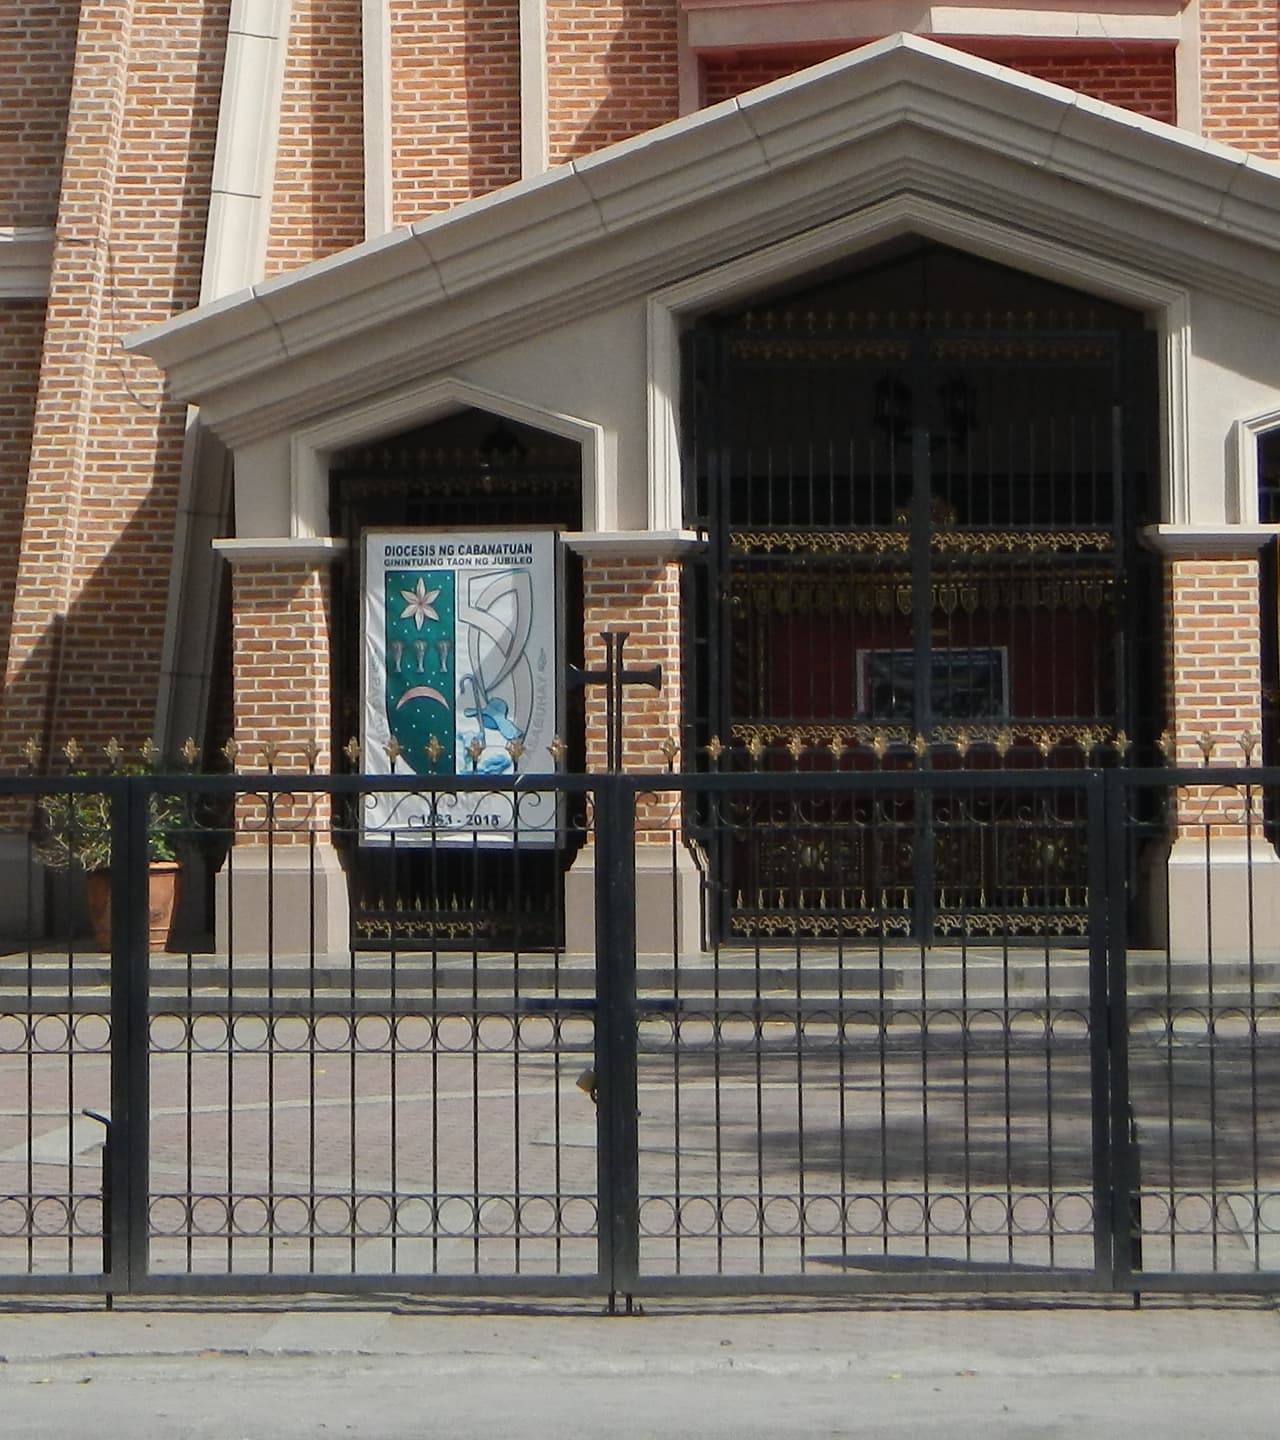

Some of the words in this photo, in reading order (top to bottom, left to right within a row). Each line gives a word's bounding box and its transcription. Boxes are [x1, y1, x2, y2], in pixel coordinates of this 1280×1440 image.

[384, 544, 436, 557] DIOCESIS
[438, 544, 455, 556] NG
[457, 542, 533, 556] CABANATUAN
[383, 558, 444, 568] GININTUANG
[447, 557, 472, 567] TAON
[474, 556, 489, 566] NG
[491, 555, 533, 566] JUBILEO
